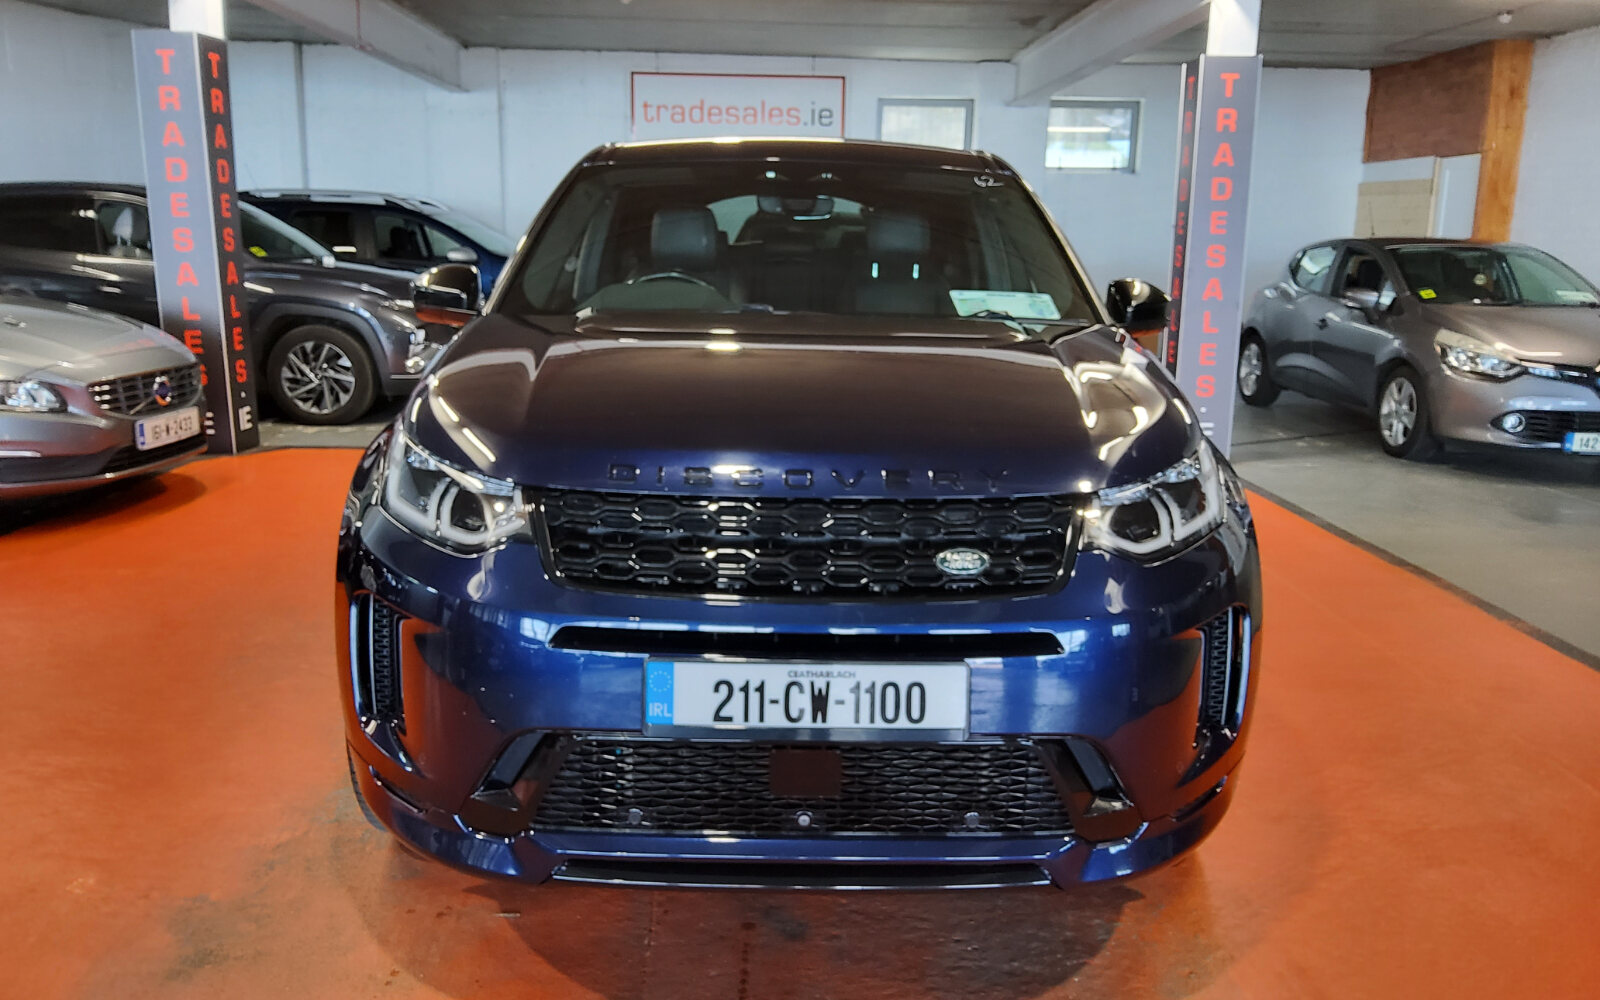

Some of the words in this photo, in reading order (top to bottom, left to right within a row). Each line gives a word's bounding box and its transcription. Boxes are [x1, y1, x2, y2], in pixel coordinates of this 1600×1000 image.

[642, 99, 834, 127] tradesales.ie
[607, 463, 1009, 492] DISCOVERY
[649, 702, 673, 717] IRL
[712, 680, 927, 724] 211-CW-1100
